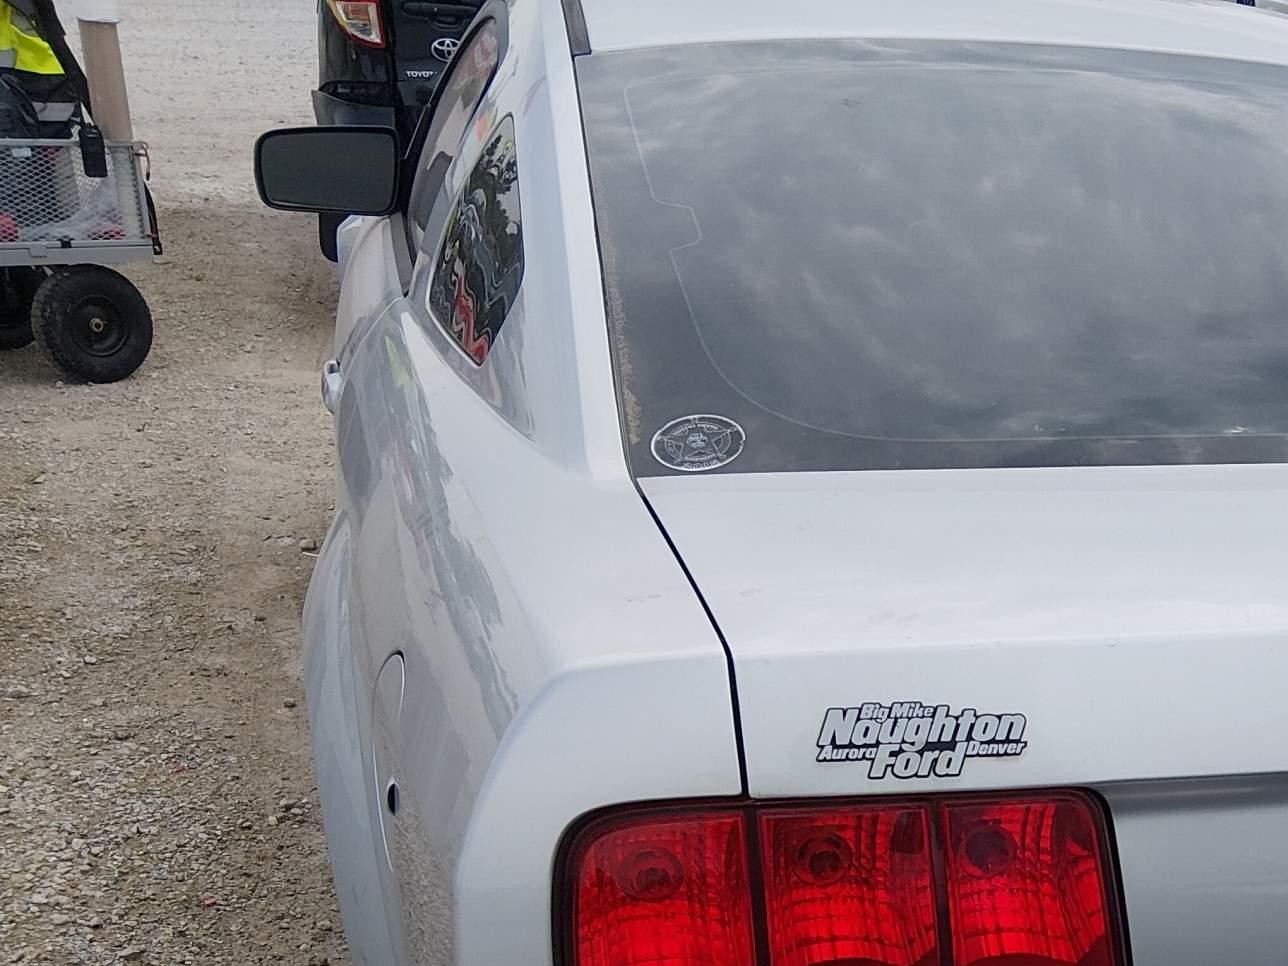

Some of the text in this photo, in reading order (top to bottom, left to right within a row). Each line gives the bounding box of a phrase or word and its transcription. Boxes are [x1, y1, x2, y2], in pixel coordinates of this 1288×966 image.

[405, 70, 437, 79] TOYOT
[859, 702, 935, 722] Big Mike
[817, 705, 1027, 752] Naughton
[816, 746, 876, 762] Aurora
[966, 740, 1027, 757] Denver
[867, 742, 968, 779] Ford
